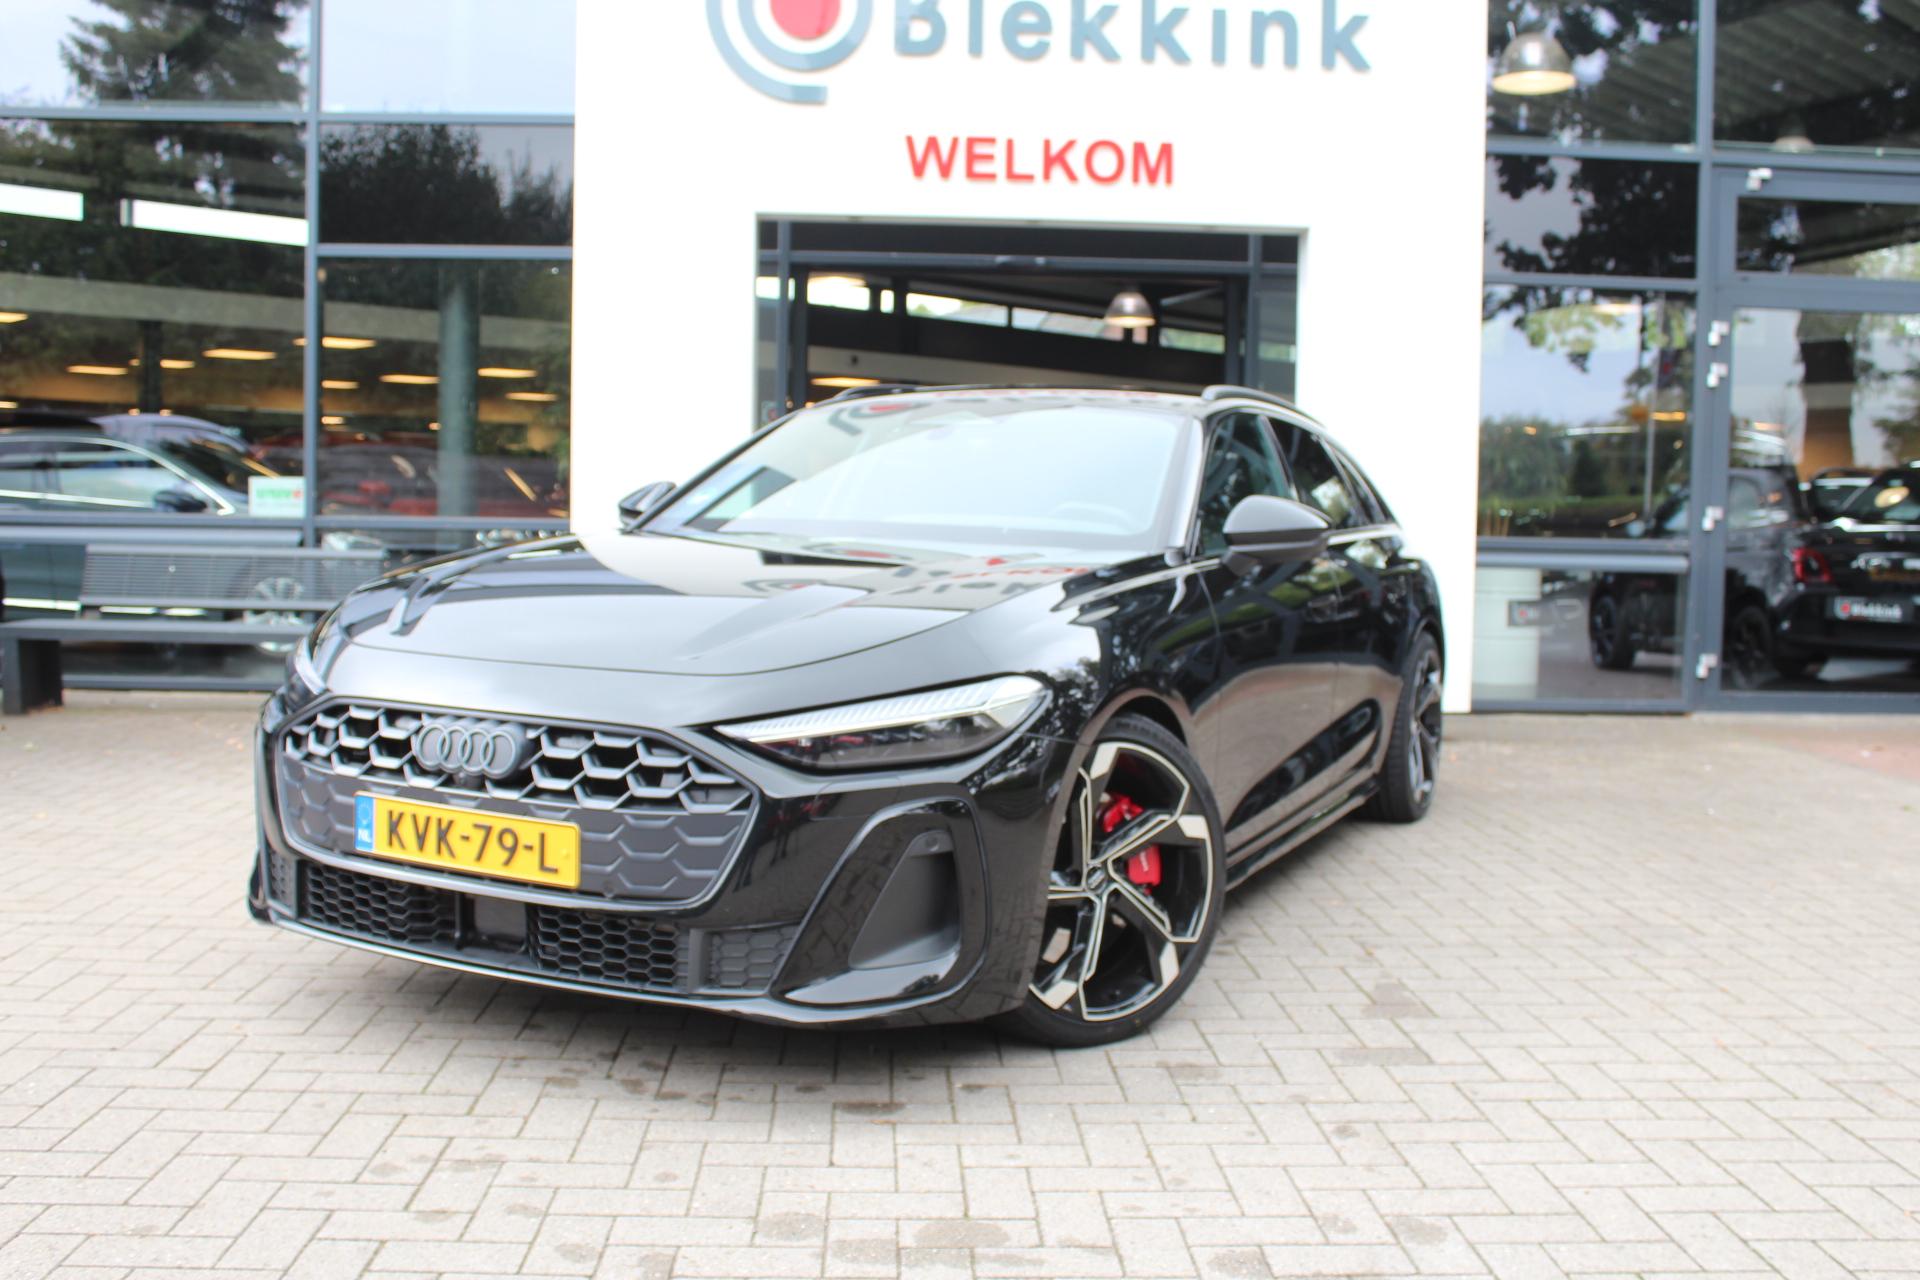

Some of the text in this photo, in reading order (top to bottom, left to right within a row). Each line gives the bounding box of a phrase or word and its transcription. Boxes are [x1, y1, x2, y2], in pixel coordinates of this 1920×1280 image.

[894, 0, 1371, 71] Blekkink
[906, 135, 1174, 185] WELKOM
[387, 810, 559, 873] KVK-79-L
